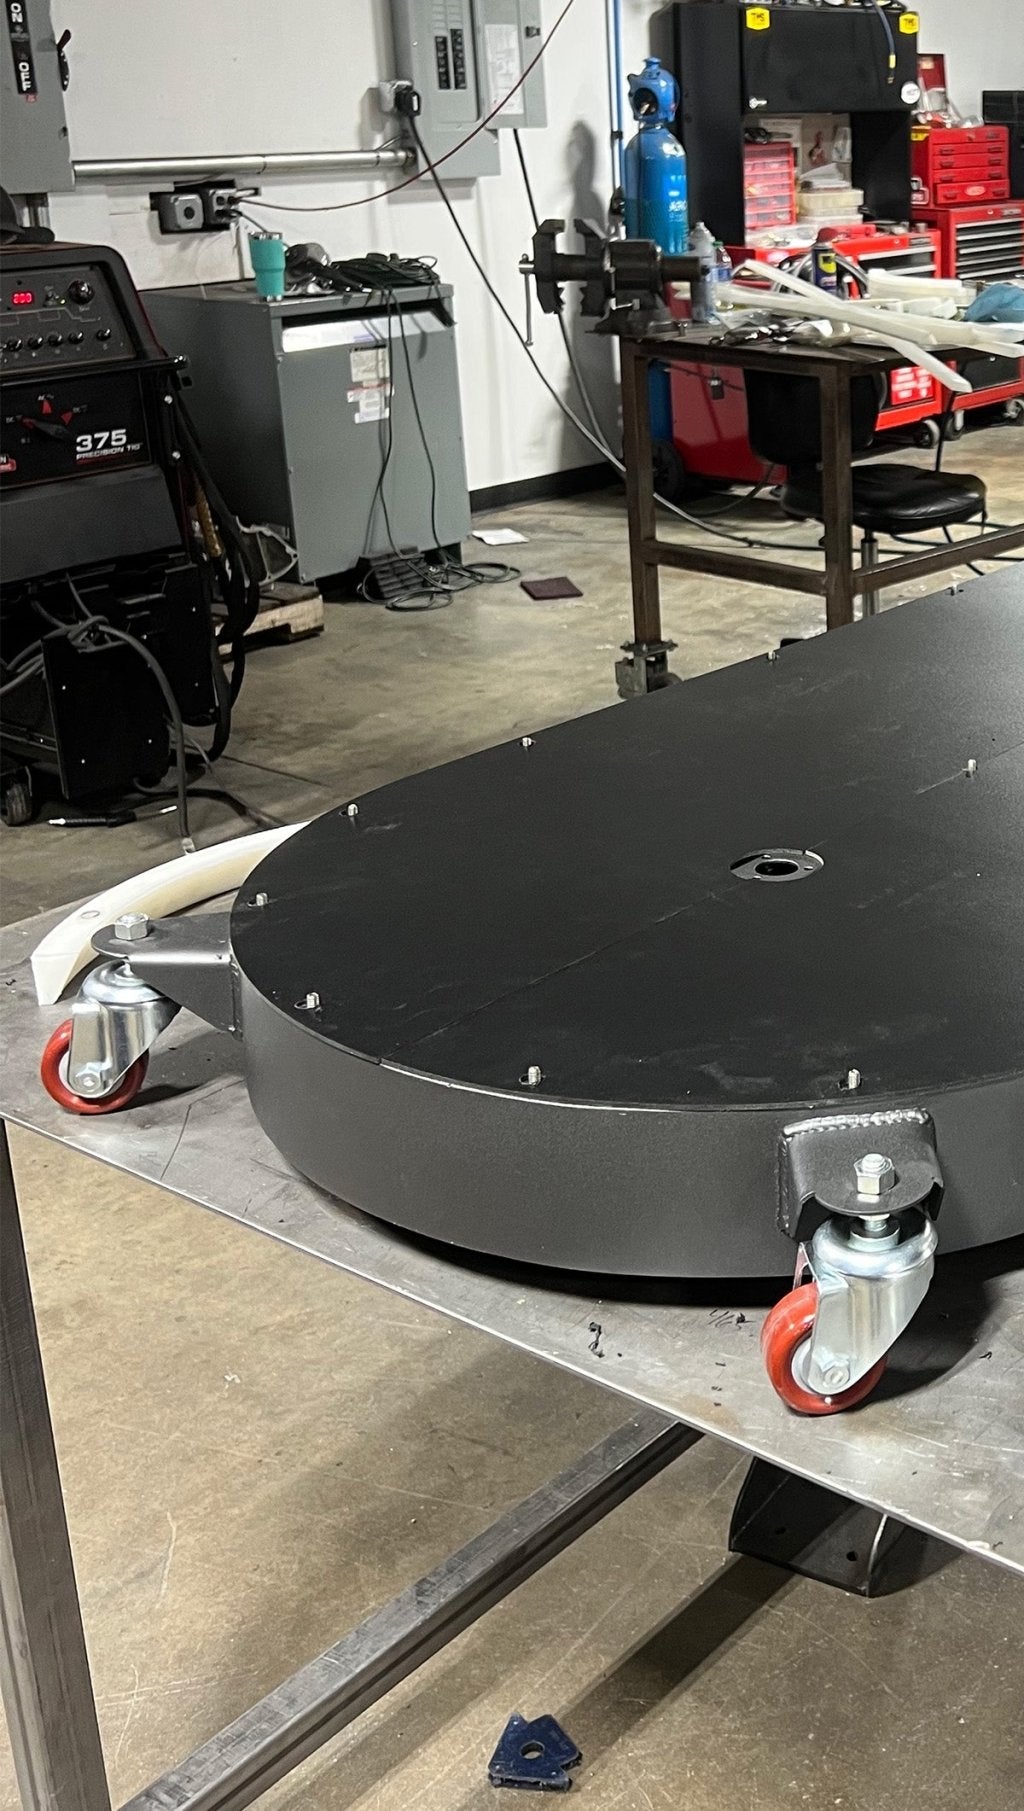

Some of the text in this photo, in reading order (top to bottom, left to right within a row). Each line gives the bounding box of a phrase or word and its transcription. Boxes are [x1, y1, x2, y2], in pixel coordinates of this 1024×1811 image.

[11, 3, 23, 23] ON
[19, 62, 32, 92] OFF
[76, 429, 127, 452] 375
[76, 447, 125, 460] PRECISION
